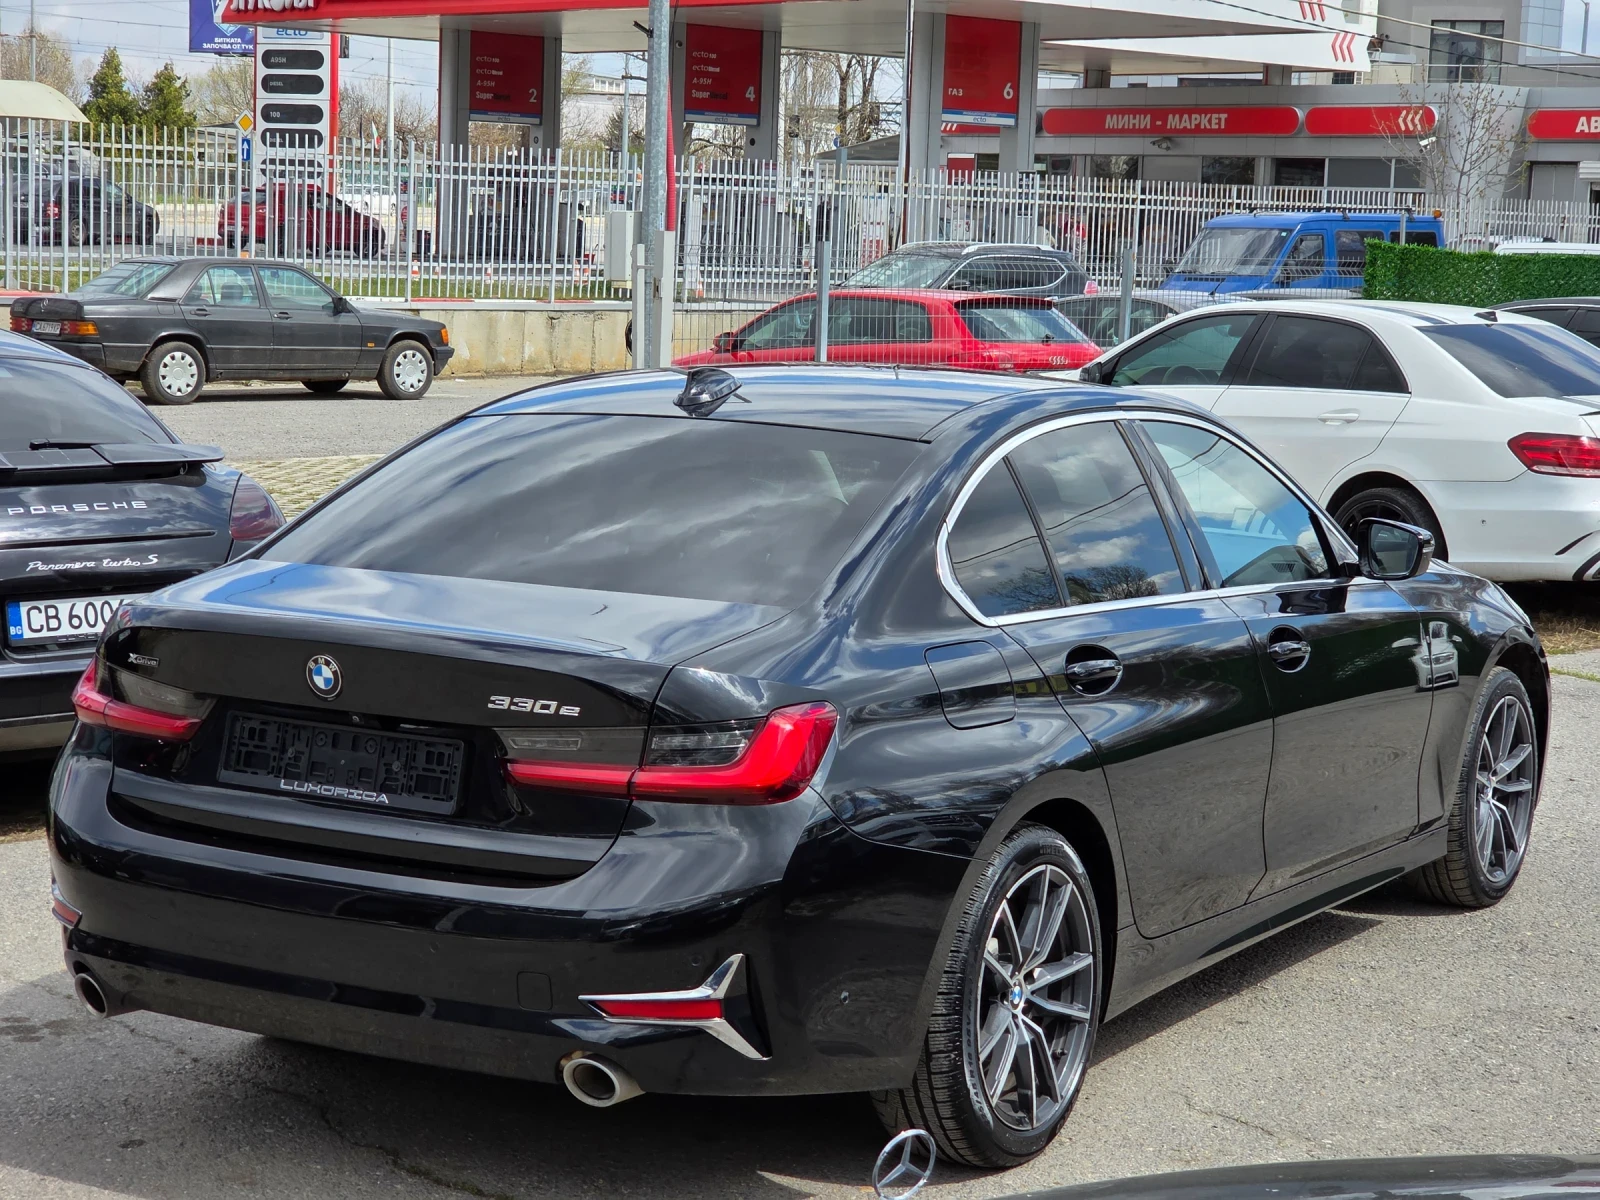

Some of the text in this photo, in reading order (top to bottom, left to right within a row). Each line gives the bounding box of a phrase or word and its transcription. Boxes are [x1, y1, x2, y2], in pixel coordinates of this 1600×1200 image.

[528, 88, 538, 103] 2
[745, 86, 756, 101] 4
[948, 87, 963, 96] ГАЗ
[1003, 82, 1014, 99] 6
[1105, 114, 1151, 129] МИНИ
[1166, 113, 1228, 129] МАРКЕТ
[7, 500, 148, 516] PORSCHE
[26, 554, 159, 572] Panamera turbo S
[27, 599, 124, 633] CB 600
[10, 625, 22, 635] BG
[309, 657, 337, 672] BMW
[280, 778, 389, 804] LUXORICA
